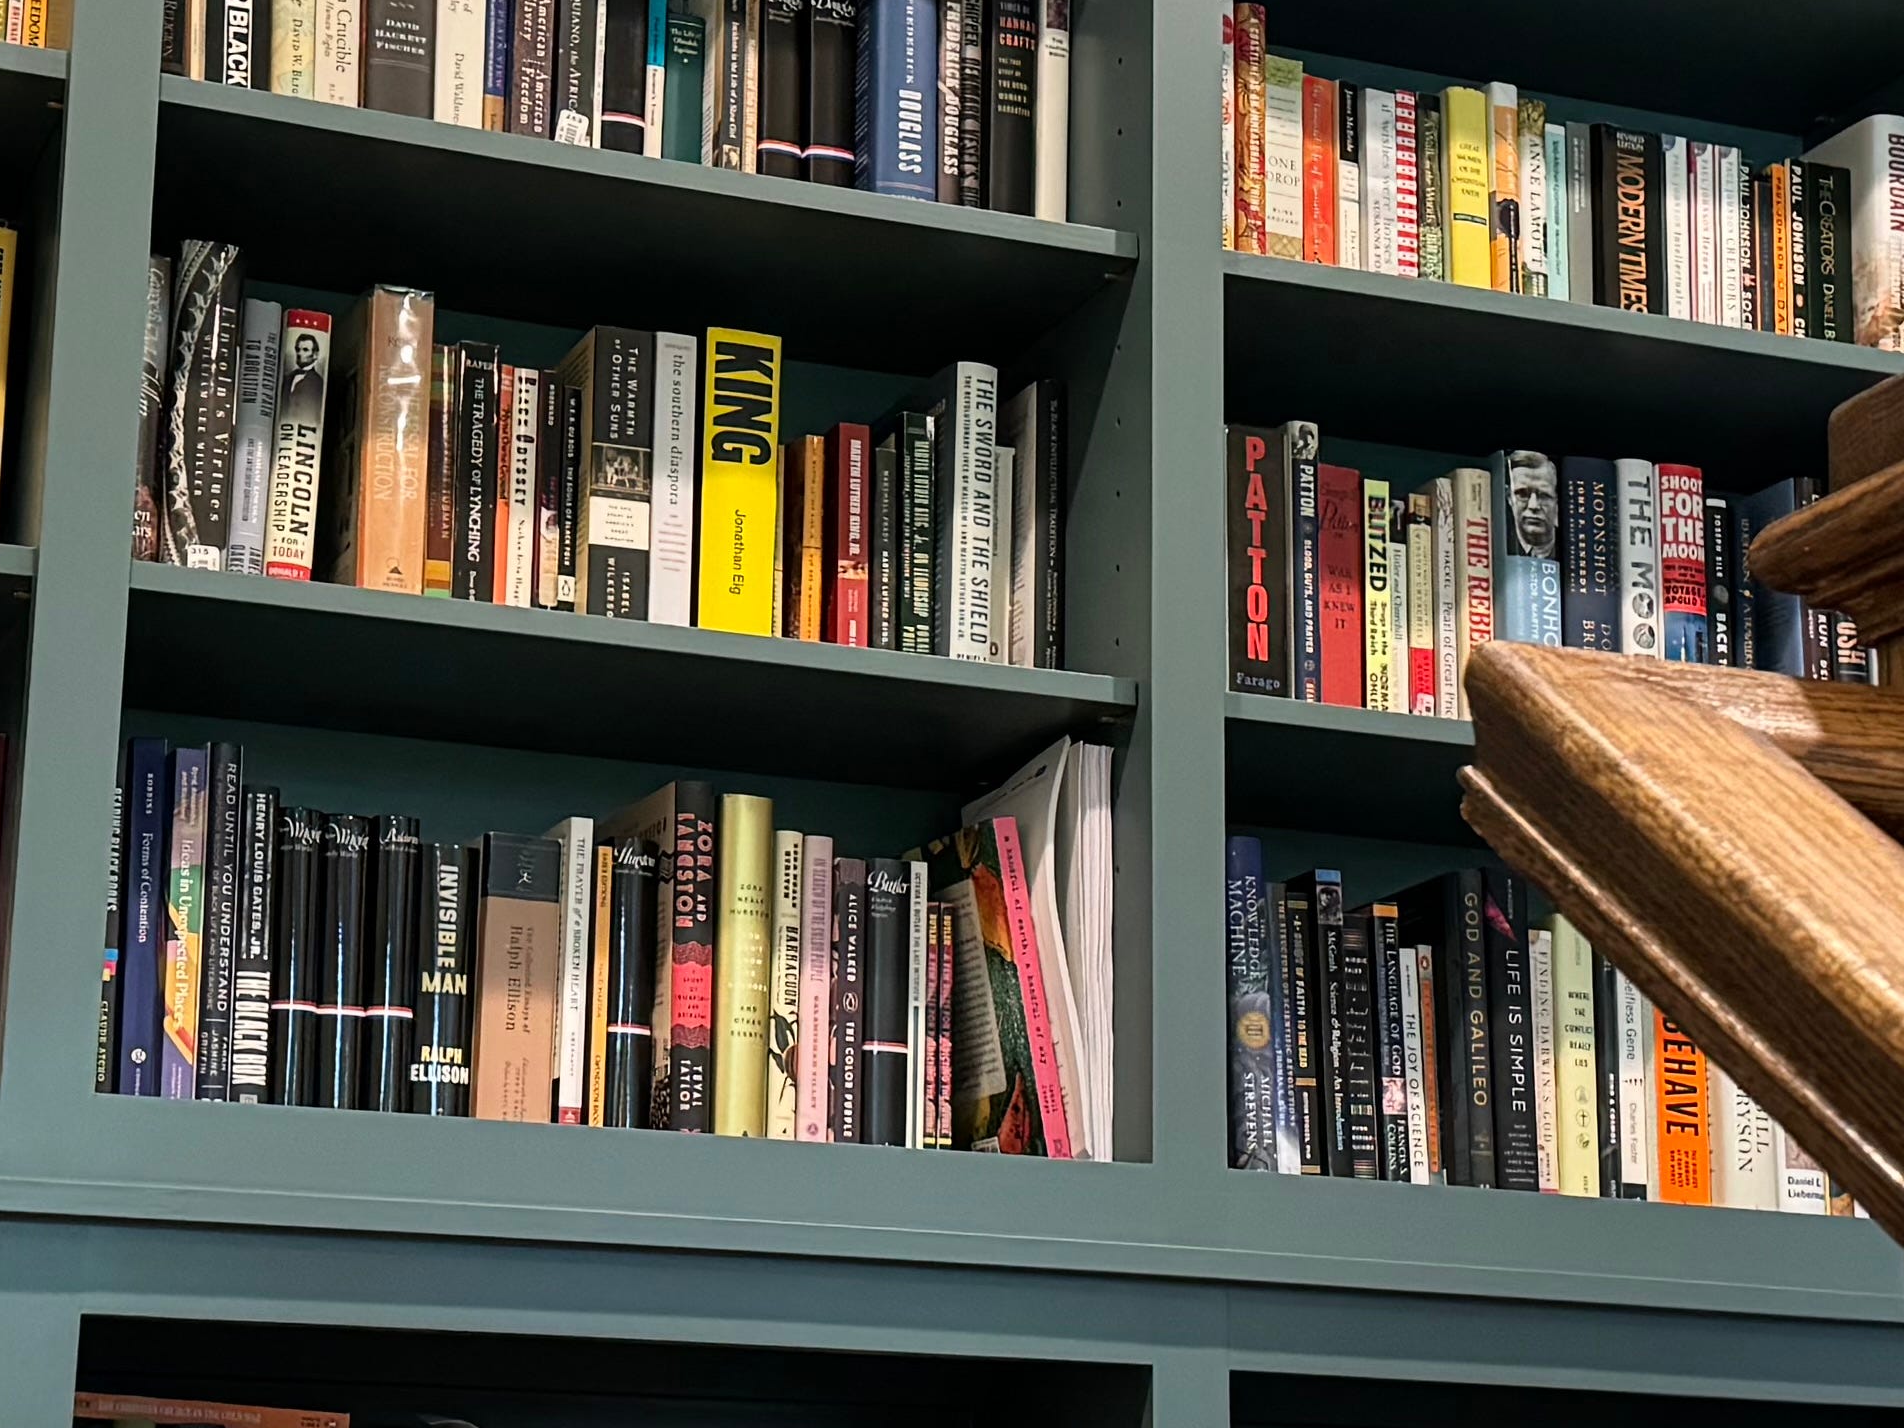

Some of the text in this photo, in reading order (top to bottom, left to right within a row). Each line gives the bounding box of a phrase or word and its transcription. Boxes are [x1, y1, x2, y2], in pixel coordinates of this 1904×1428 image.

[226, 12, 249, 86] BLACK
[898, 90, 921, 174] DOUGLASS
[1529, 137, 1543, 268] ANNE LAMOTT
[1616, 149, 1646, 246] MODERN
[712, 342, 773, 465] KING
[275, 424, 295, 532] ON LEADERSHIP
[290, 424, 317, 537] LINCOLN
[1300, 464, 1314, 518] PATTON
[1661, 475, 1703, 491] SHOOT
[1662, 492, 1703, 517] FOR
[729, 509, 745, 597] Jonathan Eig
[1245, 436, 1268, 661] PATTON
[1368, 495, 1387, 591] BLITZED
[1662, 517, 1704, 544] THE
[1663, 543, 1705, 560] MOON
[1236, 672, 1280, 689] Farago
[438, 865, 459, 969] INVISIBLE
[421, 973, 466, 994] MAN
[1465, 893, 1487, 1106] GOD AND GALILEO
[410, 1065, 468, 1084] ELLISON
[420, 1047, 462, 1063] RALPH
[1505, 951, 1526, 1112] LIFE IS SIMPLE
